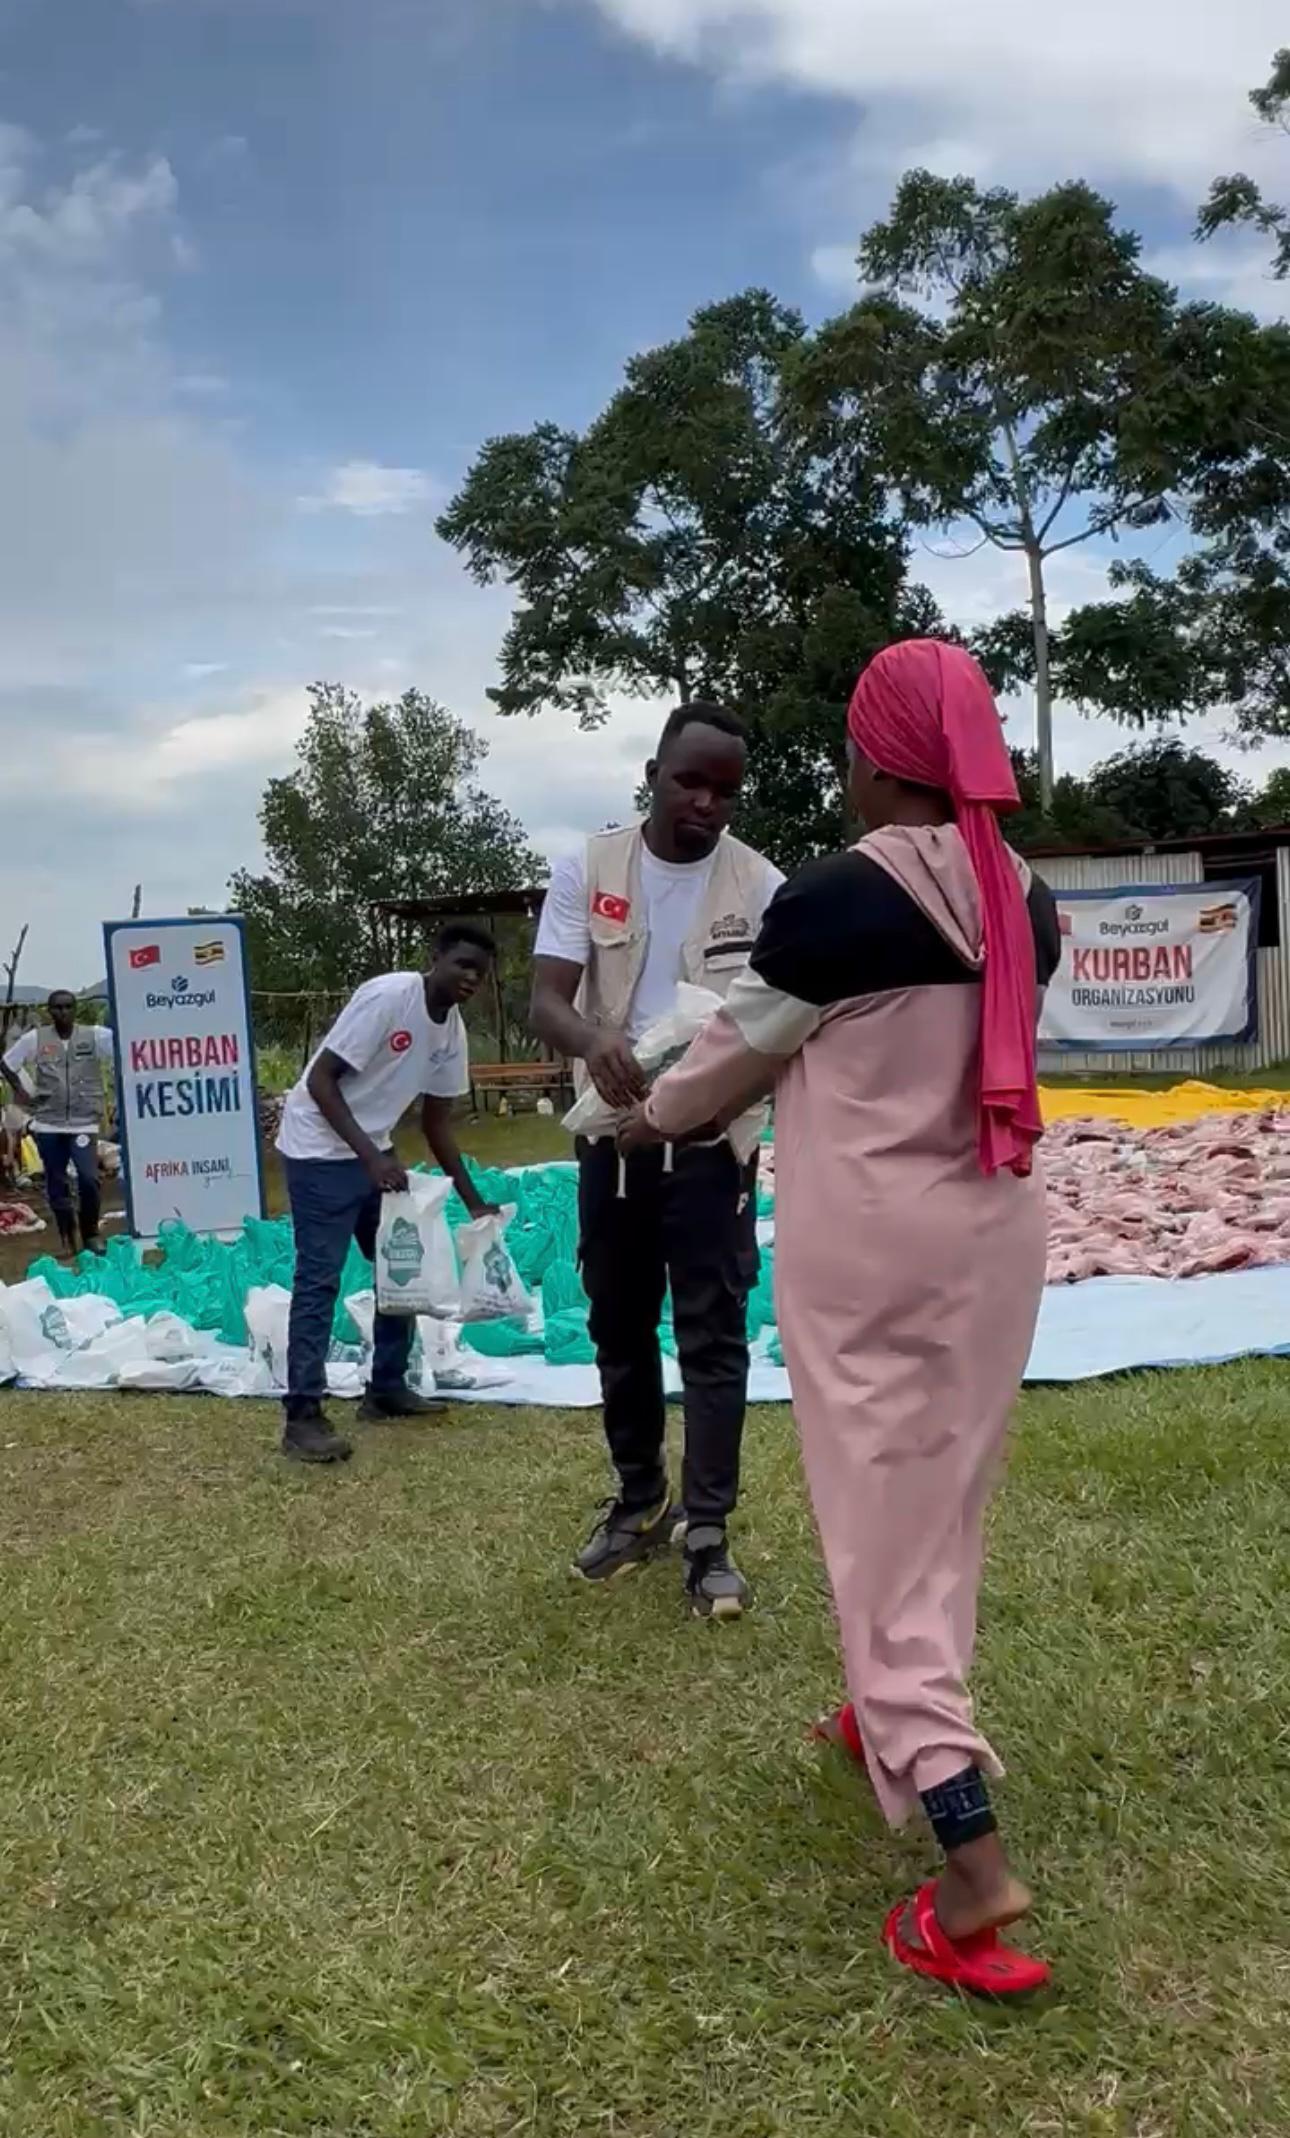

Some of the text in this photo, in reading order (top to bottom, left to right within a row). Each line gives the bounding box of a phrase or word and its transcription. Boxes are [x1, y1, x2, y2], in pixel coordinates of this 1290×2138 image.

[1073, 945, 1192, 981] KURBAN
[1072, 985, 1195, 1006] ORGANİZASYONU
[130, 1034, 238, 1072] KURBAN
[135, 1070, 241, 1120] KESİMİ
